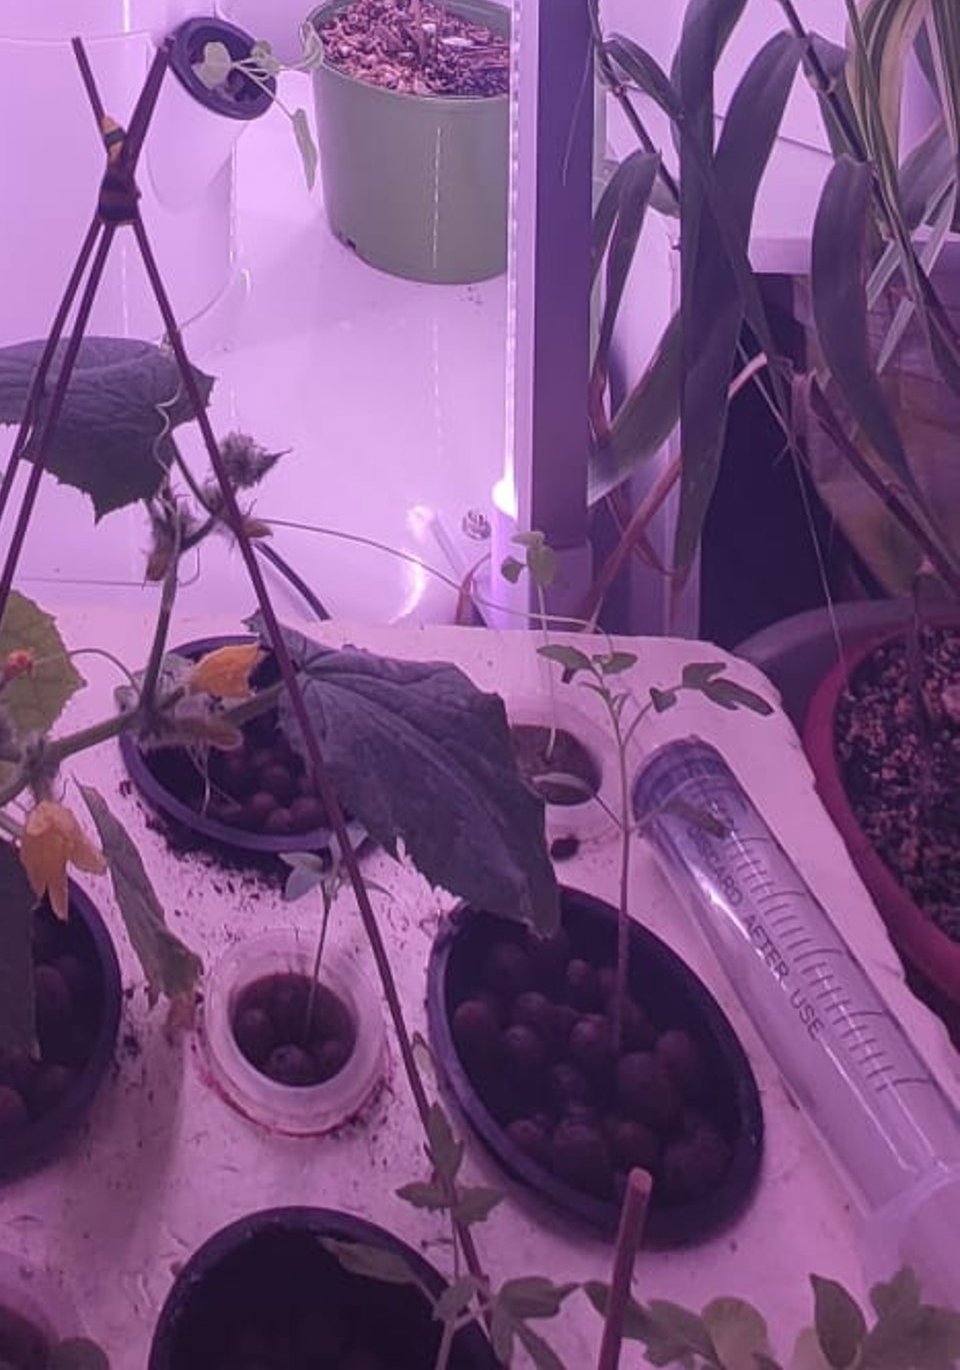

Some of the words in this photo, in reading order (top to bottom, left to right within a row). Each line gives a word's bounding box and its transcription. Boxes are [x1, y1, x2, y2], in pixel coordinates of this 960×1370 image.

[687, 825, 743, 907] DISCARD
[742, 914, 789, 981] AFTER
[791, 989, 825, 1041] USE
